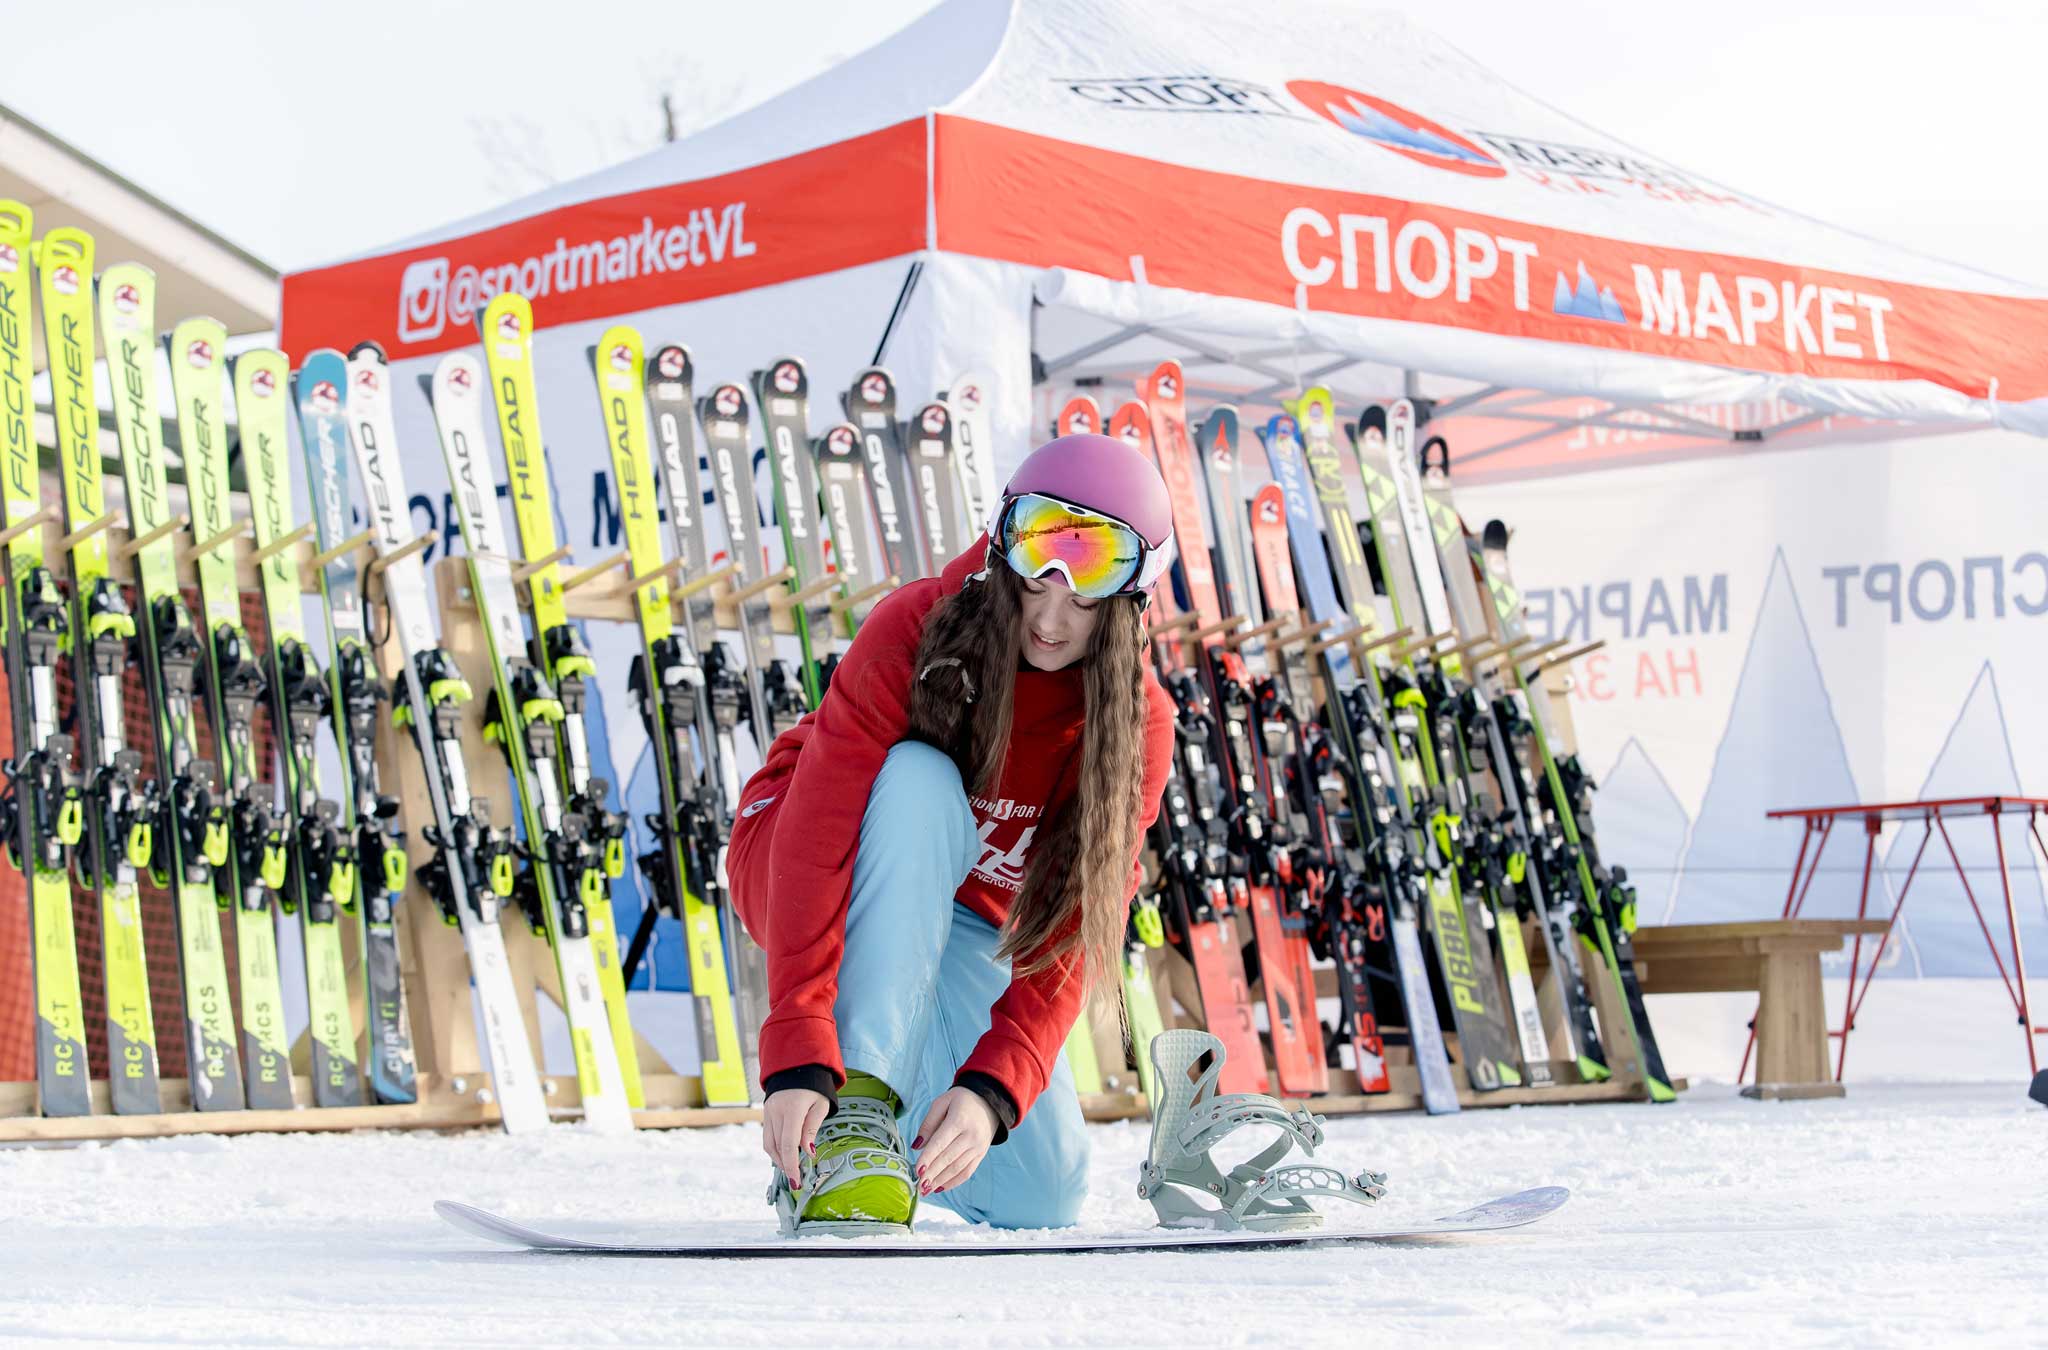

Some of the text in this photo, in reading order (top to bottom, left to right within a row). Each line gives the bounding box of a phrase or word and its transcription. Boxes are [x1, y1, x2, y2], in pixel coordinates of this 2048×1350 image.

[1070, 82, 1292, 115] СПОРТ
[449, 202, 757, 325] @sportmarketVL
[1281, 207, 1893, 361] СПОРТ МАРКЕТ
[62, 312, 96, 517] FISCHER
[121, 338, 157, 529] FISCHER
[501, 376, 534, 502] HEAD
[612, 396, 643, 519] HEAD
[659, 413, 692, 528] HEAD
[358, 420, 399, 545] HEAD
[453, 430, 491, 551] HEAD
[717, 447, 746, 541] HEAD
[775, 425, 807, 539] HEAD
[829, 483, 858, 575] HEAD
[865, 434, 901, 542] HEAD
[920, 464, 946, 554] HEAD
[1280, 462, 1308, 521] RACE
[1011, 804, 1036, 819] FOR
